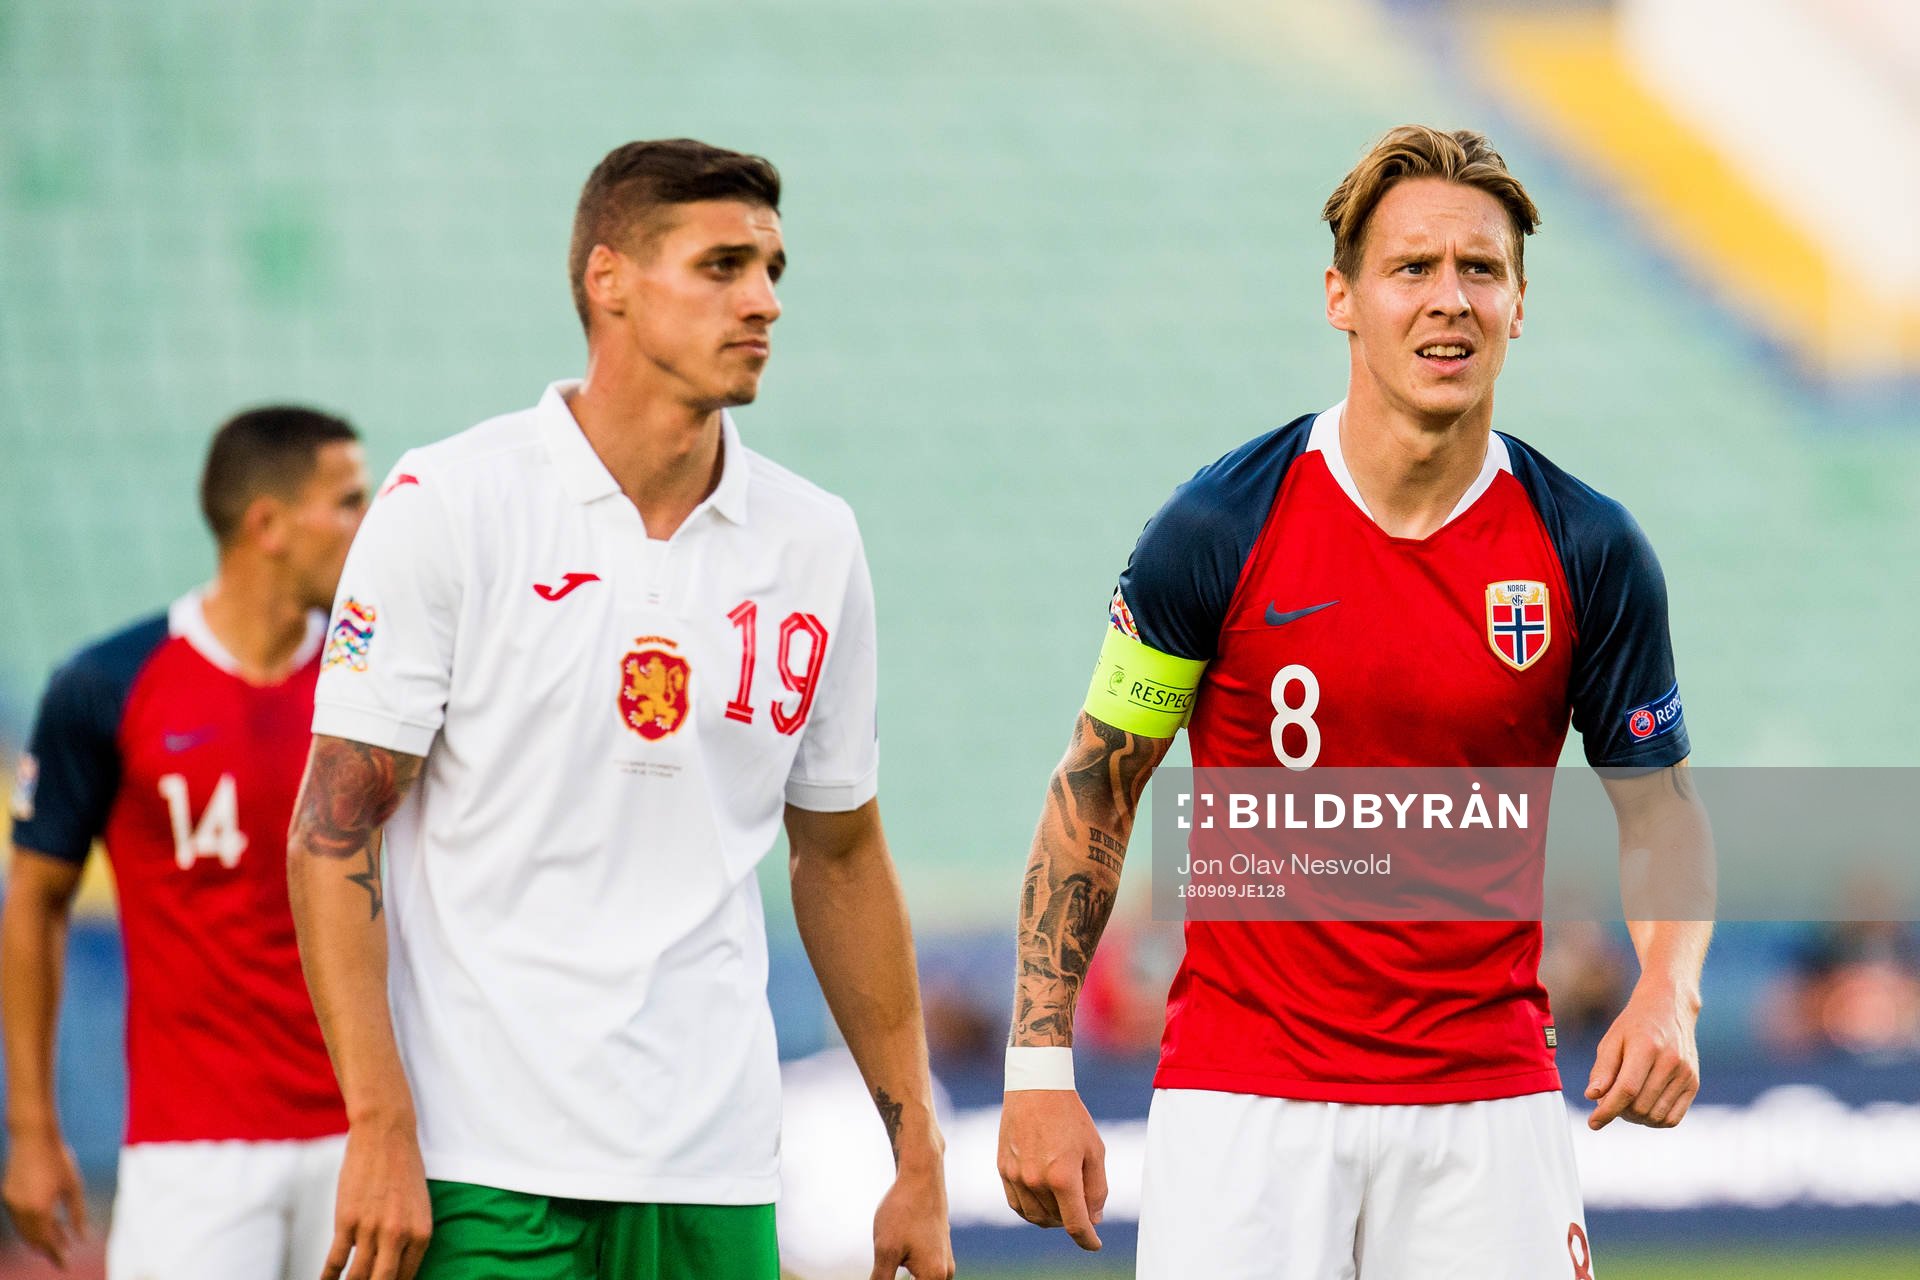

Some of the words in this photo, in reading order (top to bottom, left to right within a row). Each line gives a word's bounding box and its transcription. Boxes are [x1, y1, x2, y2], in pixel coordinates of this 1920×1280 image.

[1507, 584, 1527, 593] NORGE
[724, 600, 829, 736] 19
[1270, 664, 1321, 771] 8
[158, 773, 248, 870] 14
